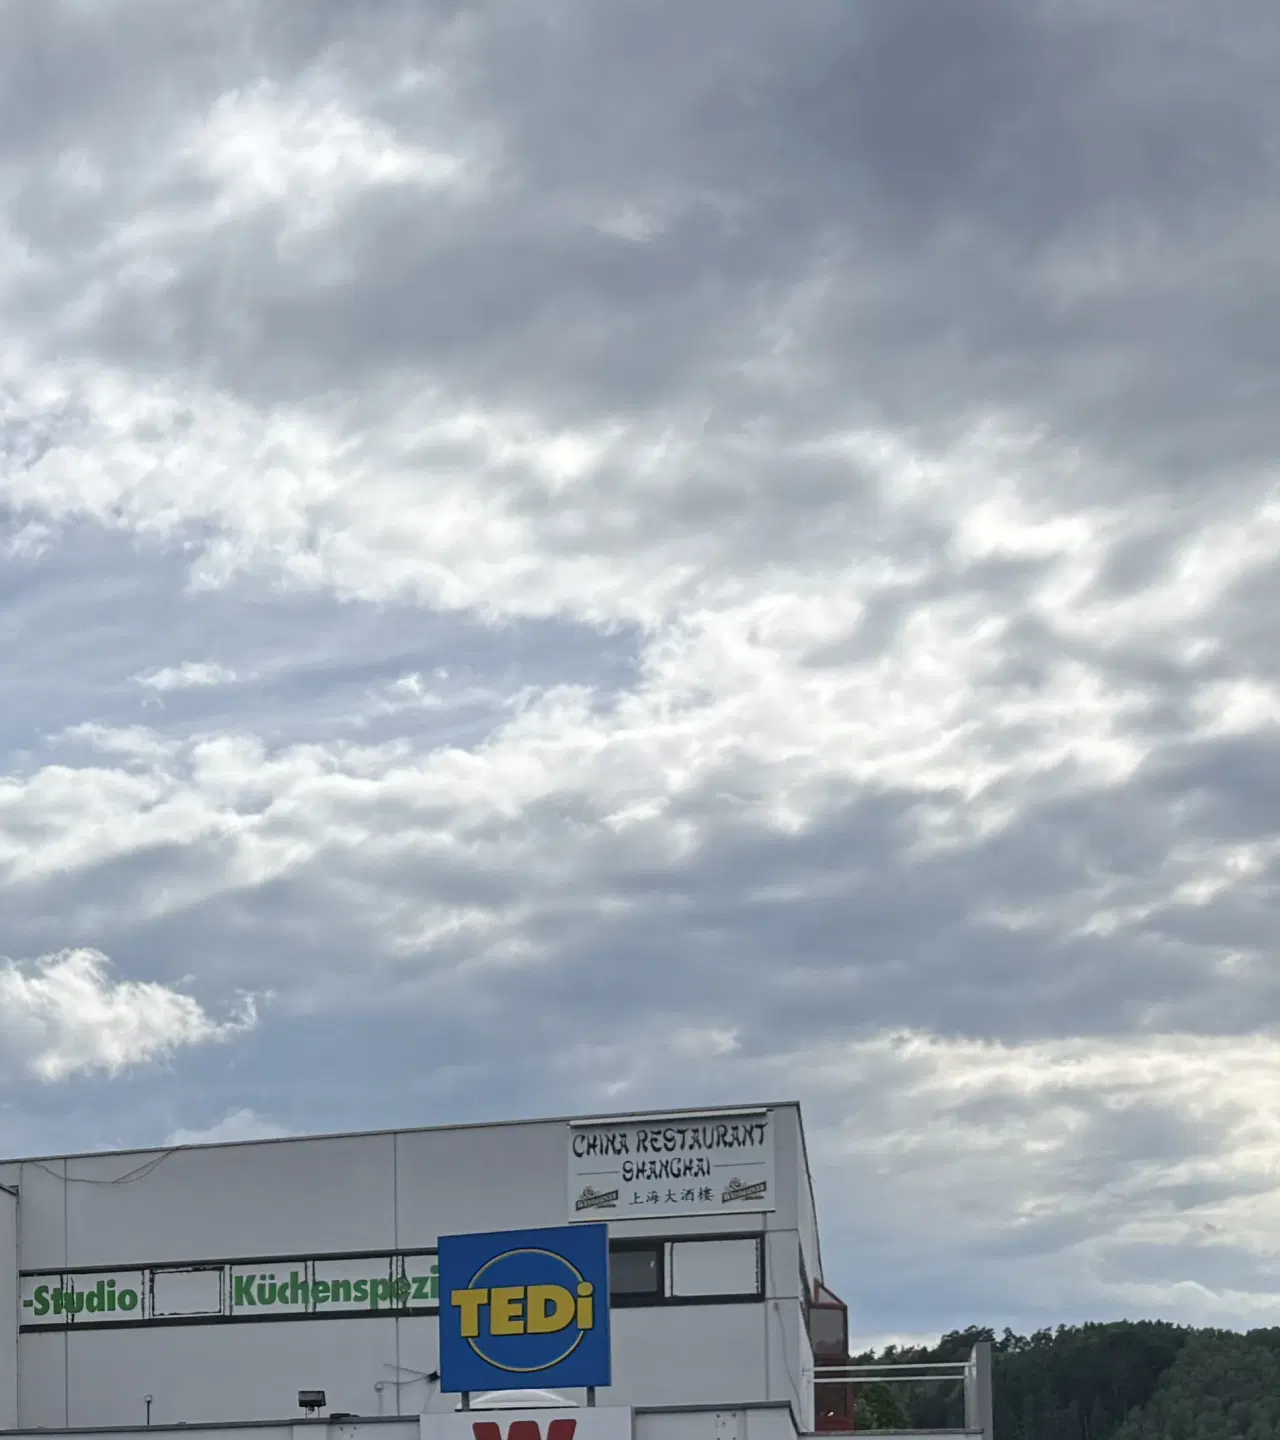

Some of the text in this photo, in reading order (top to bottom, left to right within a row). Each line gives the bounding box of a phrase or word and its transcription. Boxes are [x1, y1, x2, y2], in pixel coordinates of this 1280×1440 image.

[572, 1121, 769, 1158] CHINA RESTAURANT
[622, 1156, 711, 1182] SHANGHAI
